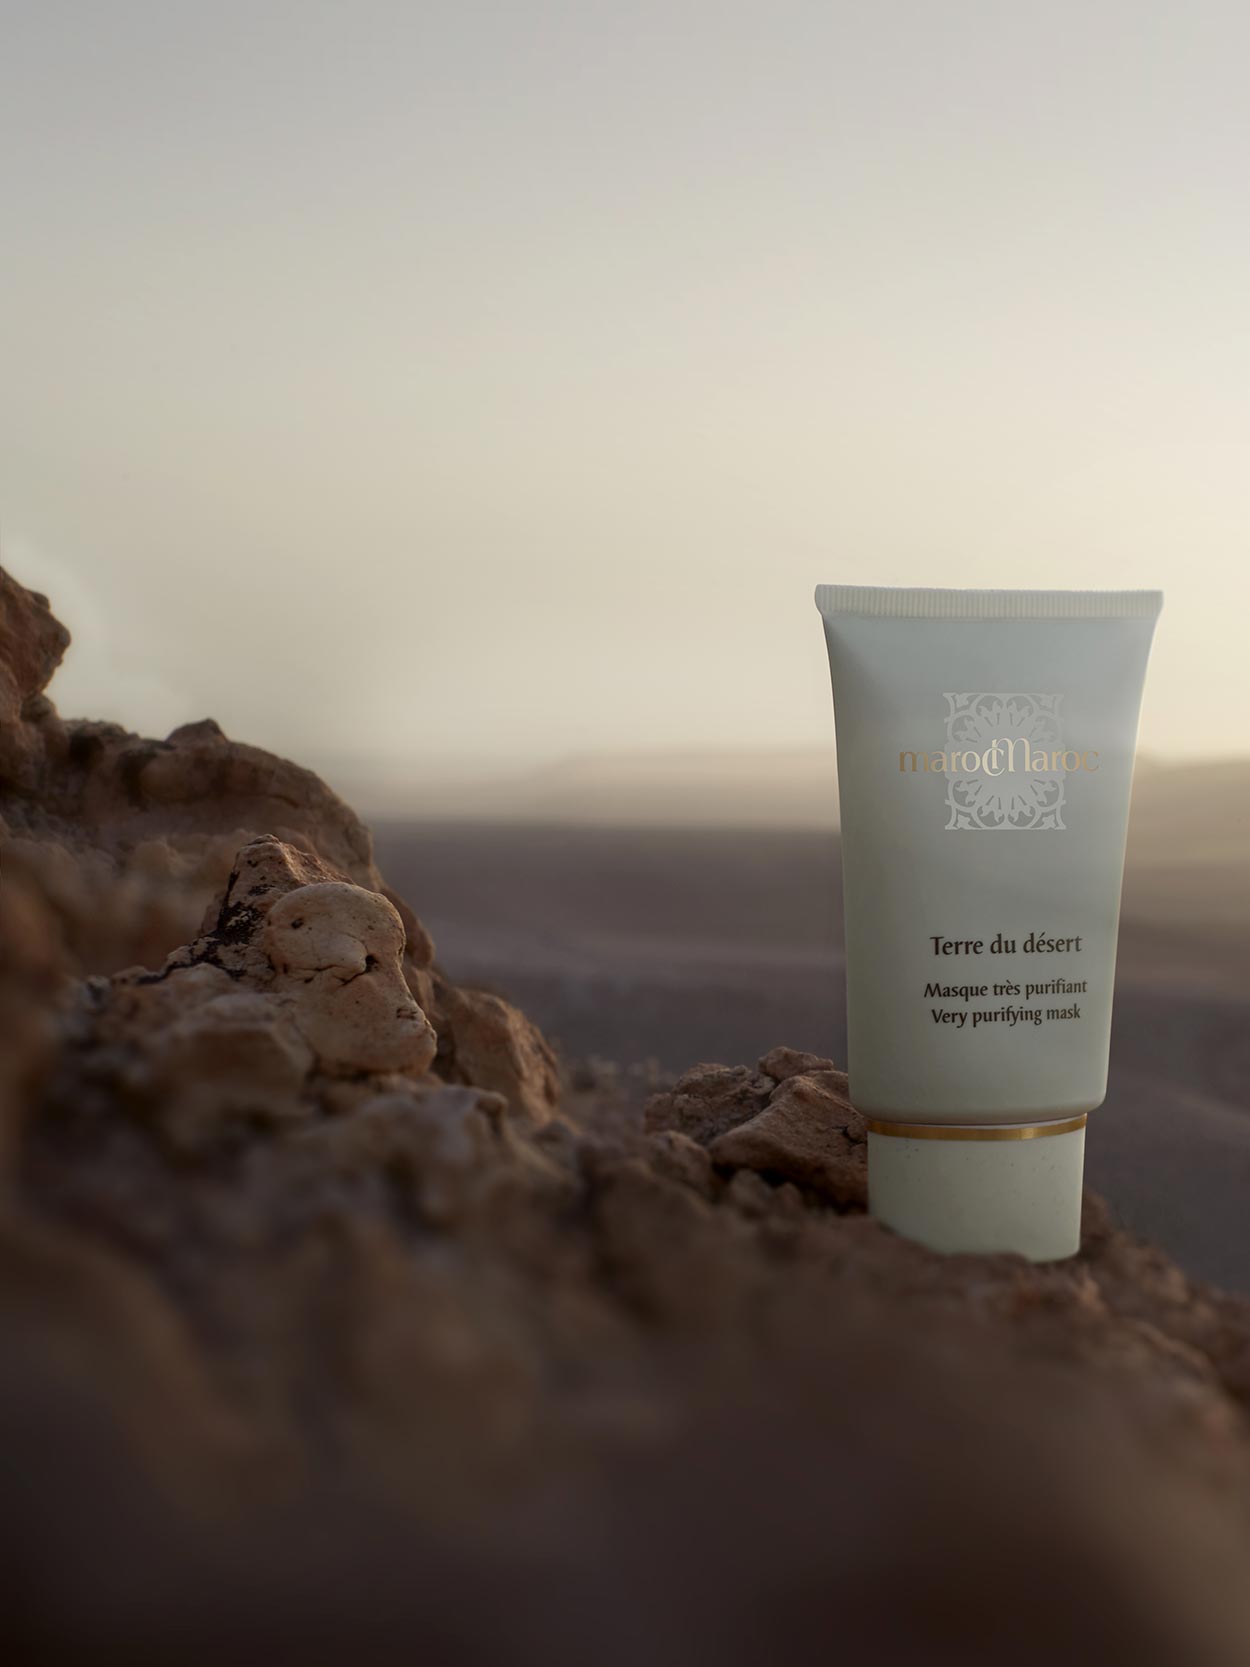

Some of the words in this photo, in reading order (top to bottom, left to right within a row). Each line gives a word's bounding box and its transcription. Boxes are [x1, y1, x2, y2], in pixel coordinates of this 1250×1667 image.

[930, 935, 984, 956] Terre
[990, 933, 1017, 955] du
[1023, 932, 1084, 954] désert
[924, 982, 989, 1002] Masque
[993, 979, 1021, 997] très
[1025, 978, 1088, 1001] purifiant
[931, 1008, 969, 1029] Very
[972, 1005, 1043, 1028] purifying
[1046, 1003, 1082, 1020] mask
